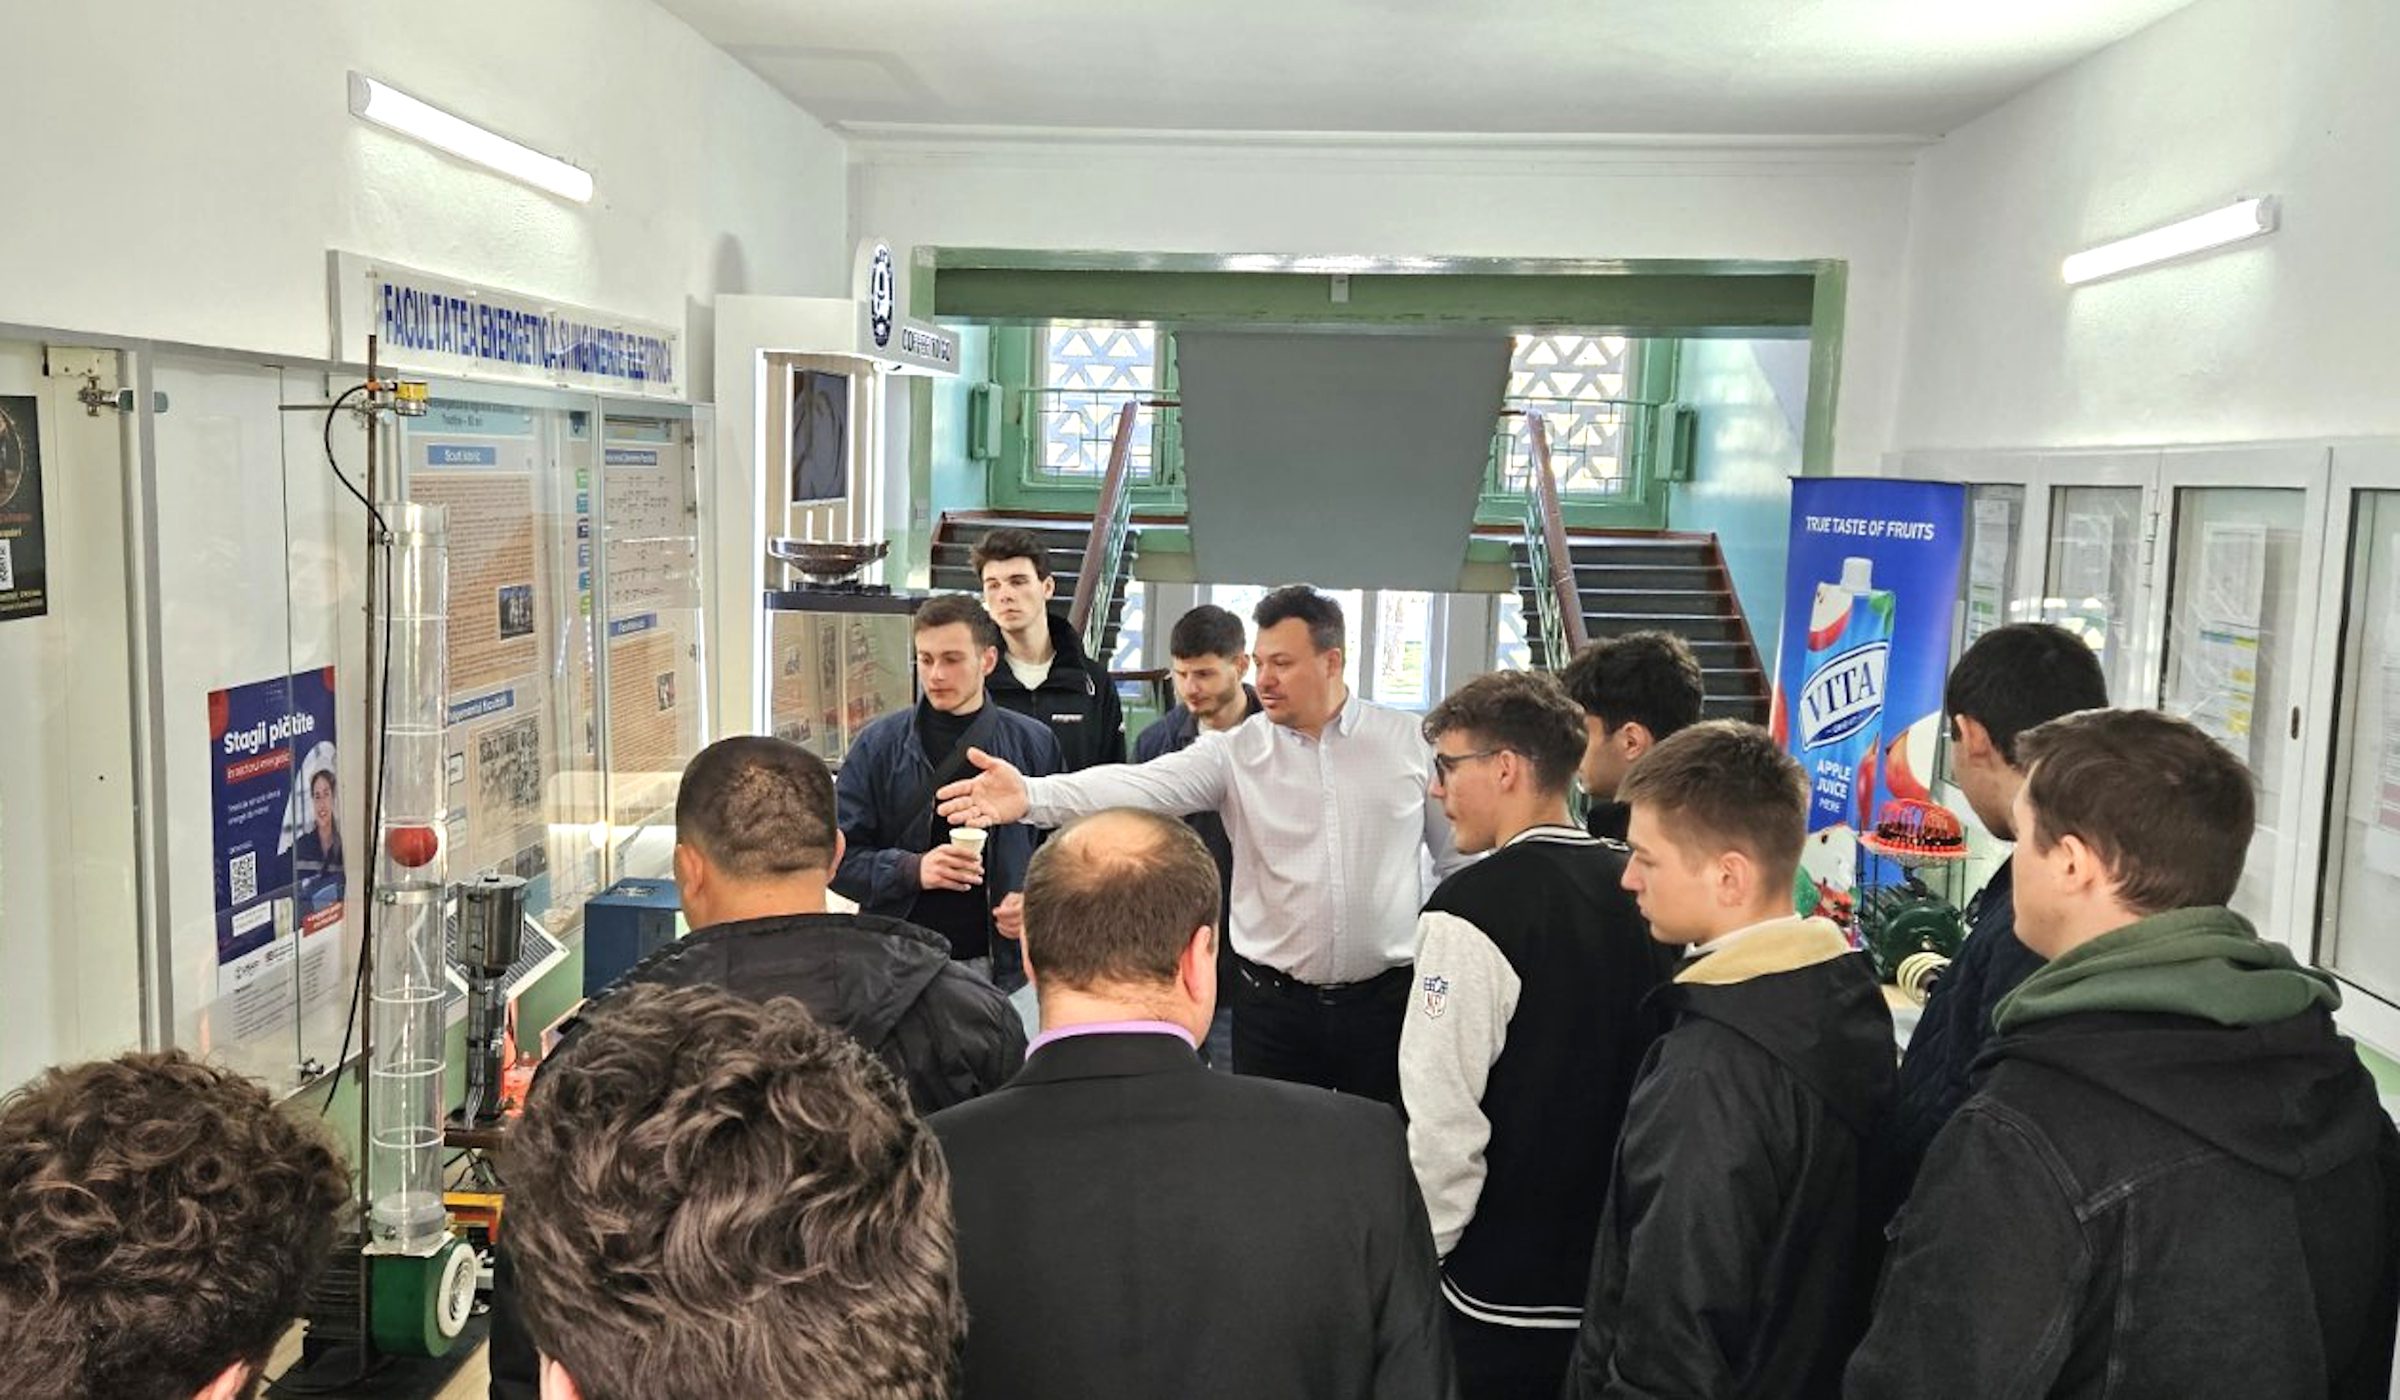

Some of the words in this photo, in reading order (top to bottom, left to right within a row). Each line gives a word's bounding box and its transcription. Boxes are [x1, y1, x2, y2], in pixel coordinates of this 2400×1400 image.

[384, 284, 479, 357] FACULTATEA
[1806, 515, 1832, 533] TRUE
[1832, 517, 1867, 536] TASTE
[1868, 520, 1885, 537] OF
[1885, 521, 1935, 541] FRUITS
[1807, 661, 1877, 722] VITA
[223, 720, 267, 754] Stagii
[269, 711, 315, 749] plătite
[1817, 758, 1851, 781] APPLE
[1816, 777, 1848, 799] JUICE
